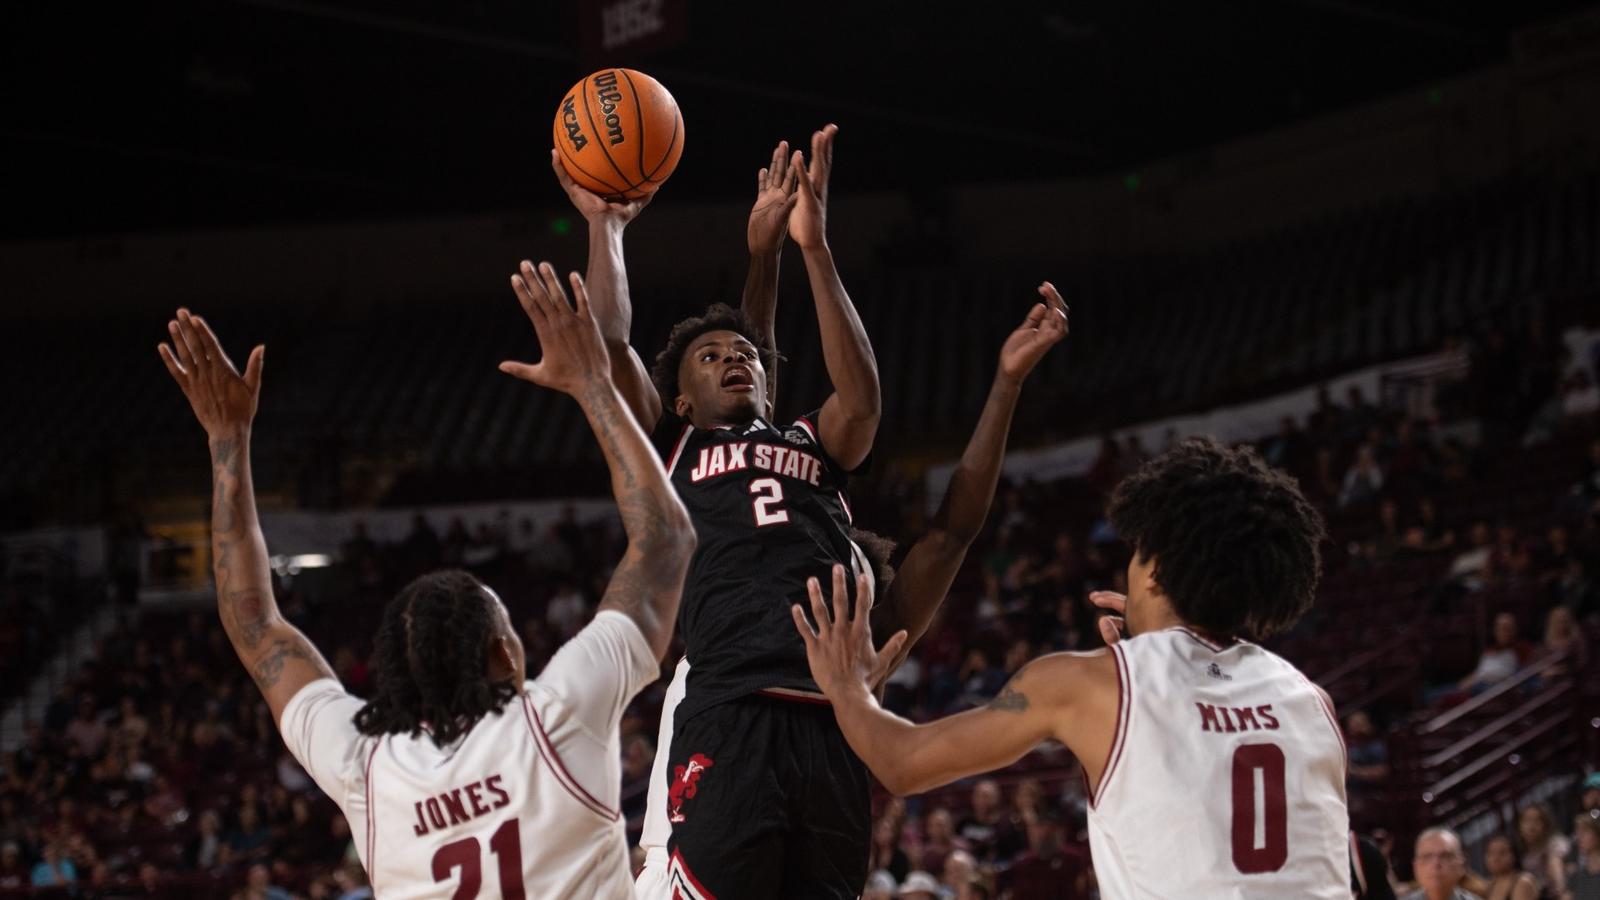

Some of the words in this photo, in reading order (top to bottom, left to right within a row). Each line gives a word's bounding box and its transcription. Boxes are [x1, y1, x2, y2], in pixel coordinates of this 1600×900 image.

[562, 94, 588, 152] NCAA
[594, 71, 625, 146] Wilson
[690, 442, 749, 483] JAX
[754, 443, 822, 487] STATE
[749, 476, 789, 528] 2
[1195, 702, 1280, 733] MIMS
[413, 774, 511, 837] JONES
[1231, 742, 1288, 874] 0
